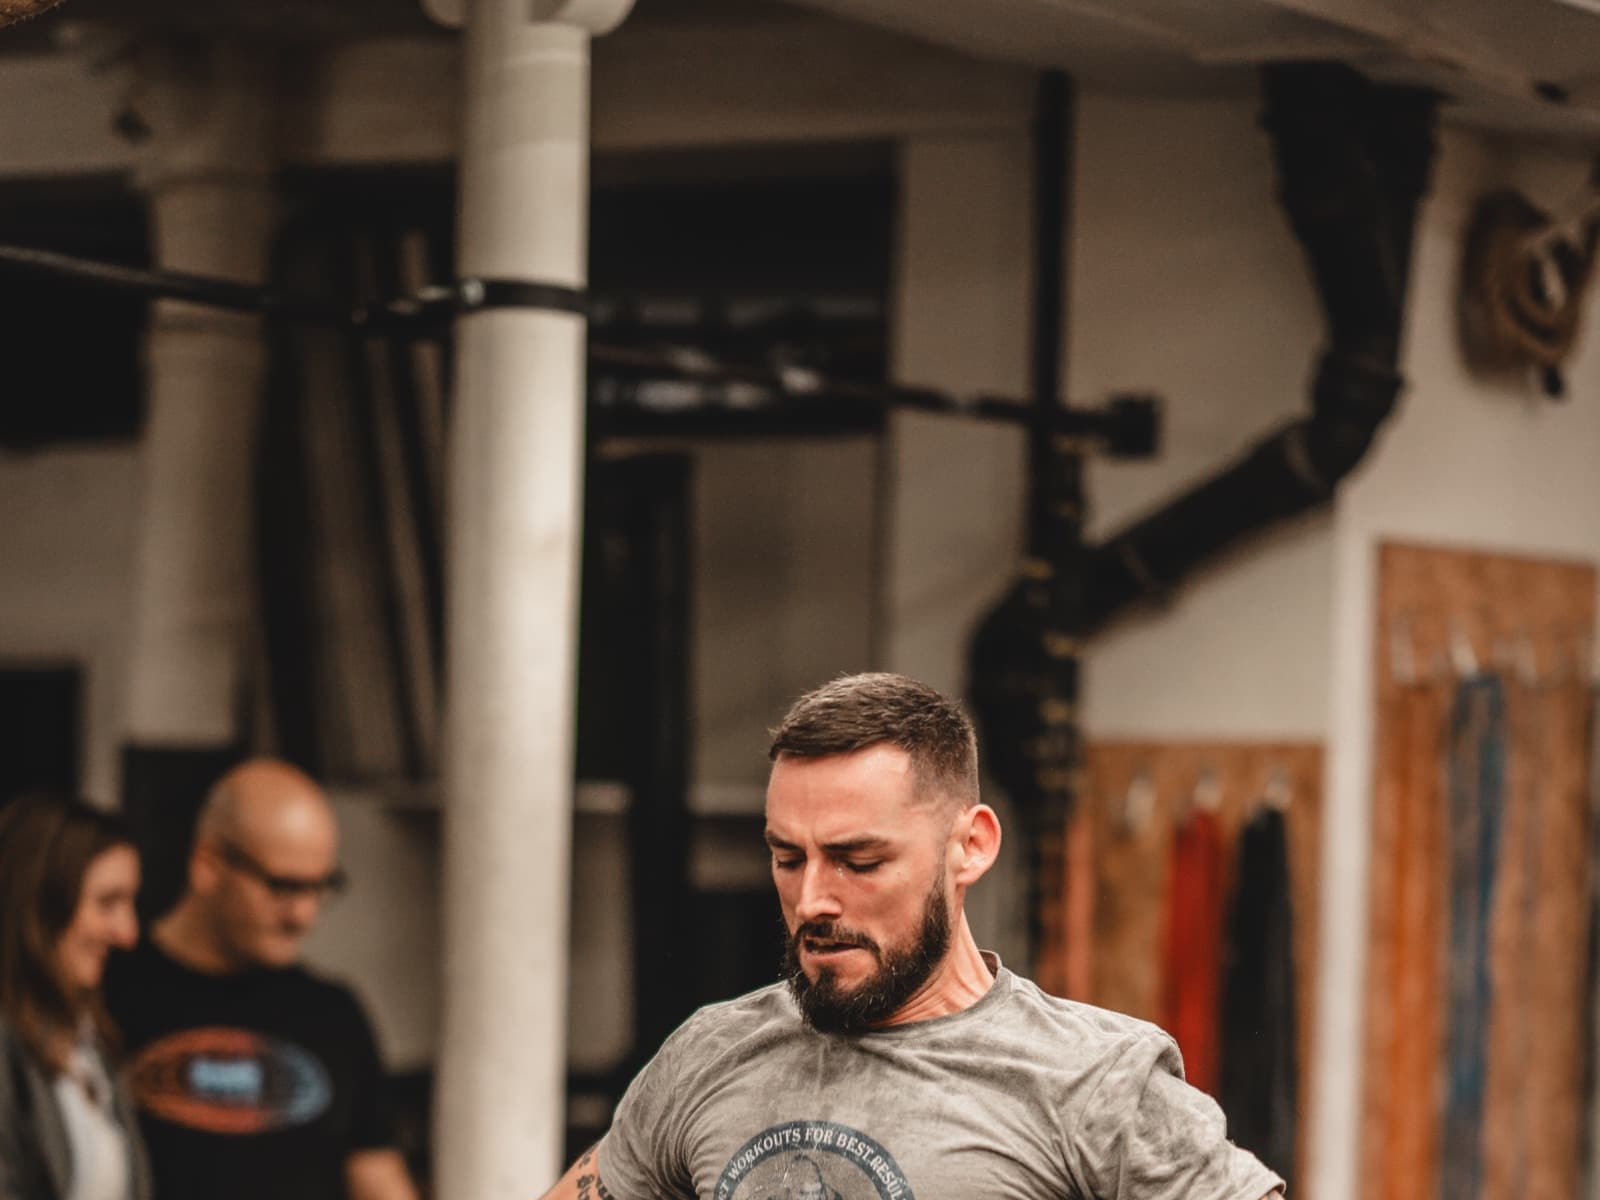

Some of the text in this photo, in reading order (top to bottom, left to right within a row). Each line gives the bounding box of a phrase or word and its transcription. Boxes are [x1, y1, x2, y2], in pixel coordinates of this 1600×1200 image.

[727, 1126, 802, 1181] WORKOUTS
[804, 1126, 834, 1144] FOR
[836, 1131, 875, 1160] BEST
